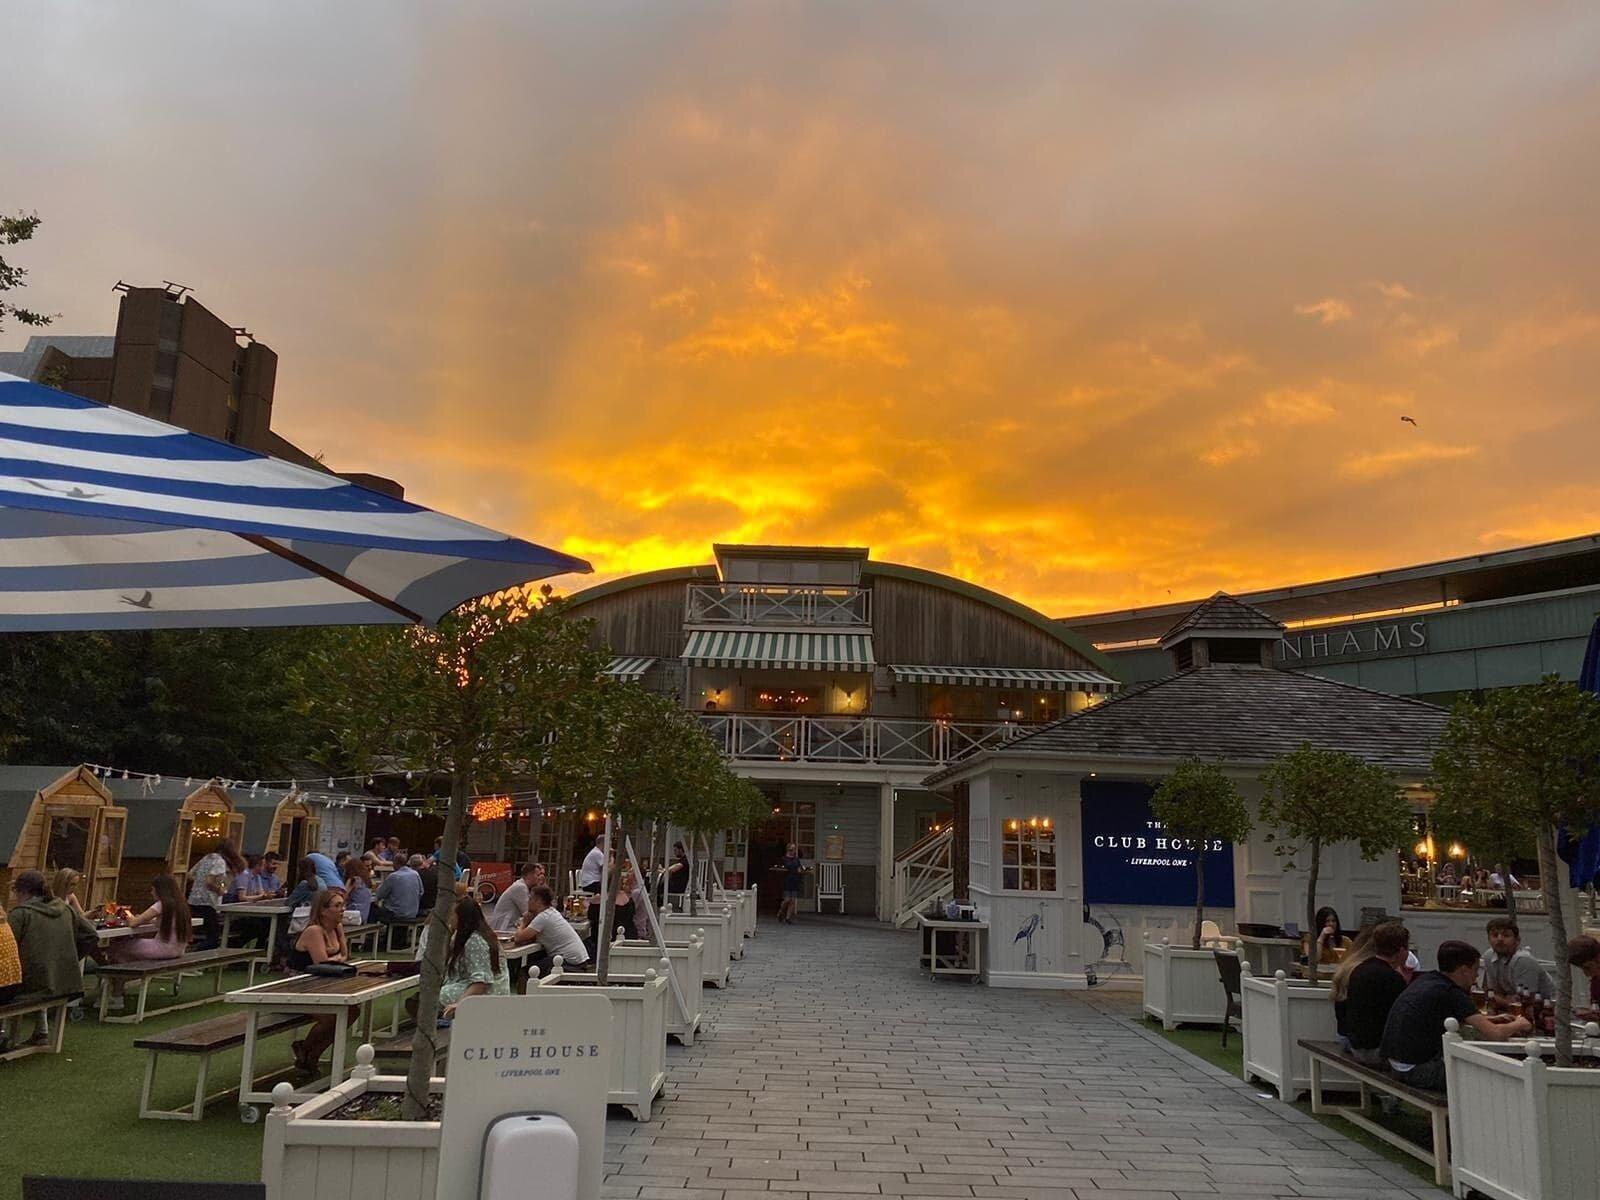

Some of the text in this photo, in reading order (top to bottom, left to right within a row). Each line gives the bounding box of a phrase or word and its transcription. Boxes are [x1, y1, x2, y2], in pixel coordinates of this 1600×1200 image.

[1094, 836, 1146, 849] CLUB
[1130, 858, 1188, 867] LIVERPOOL ONE
[523, 1028, 547, 1036] THE
[463, 1045, 600, 1060] CLUB HOUSE
[500, 1068, 544, 1078] LIVERPOOL
